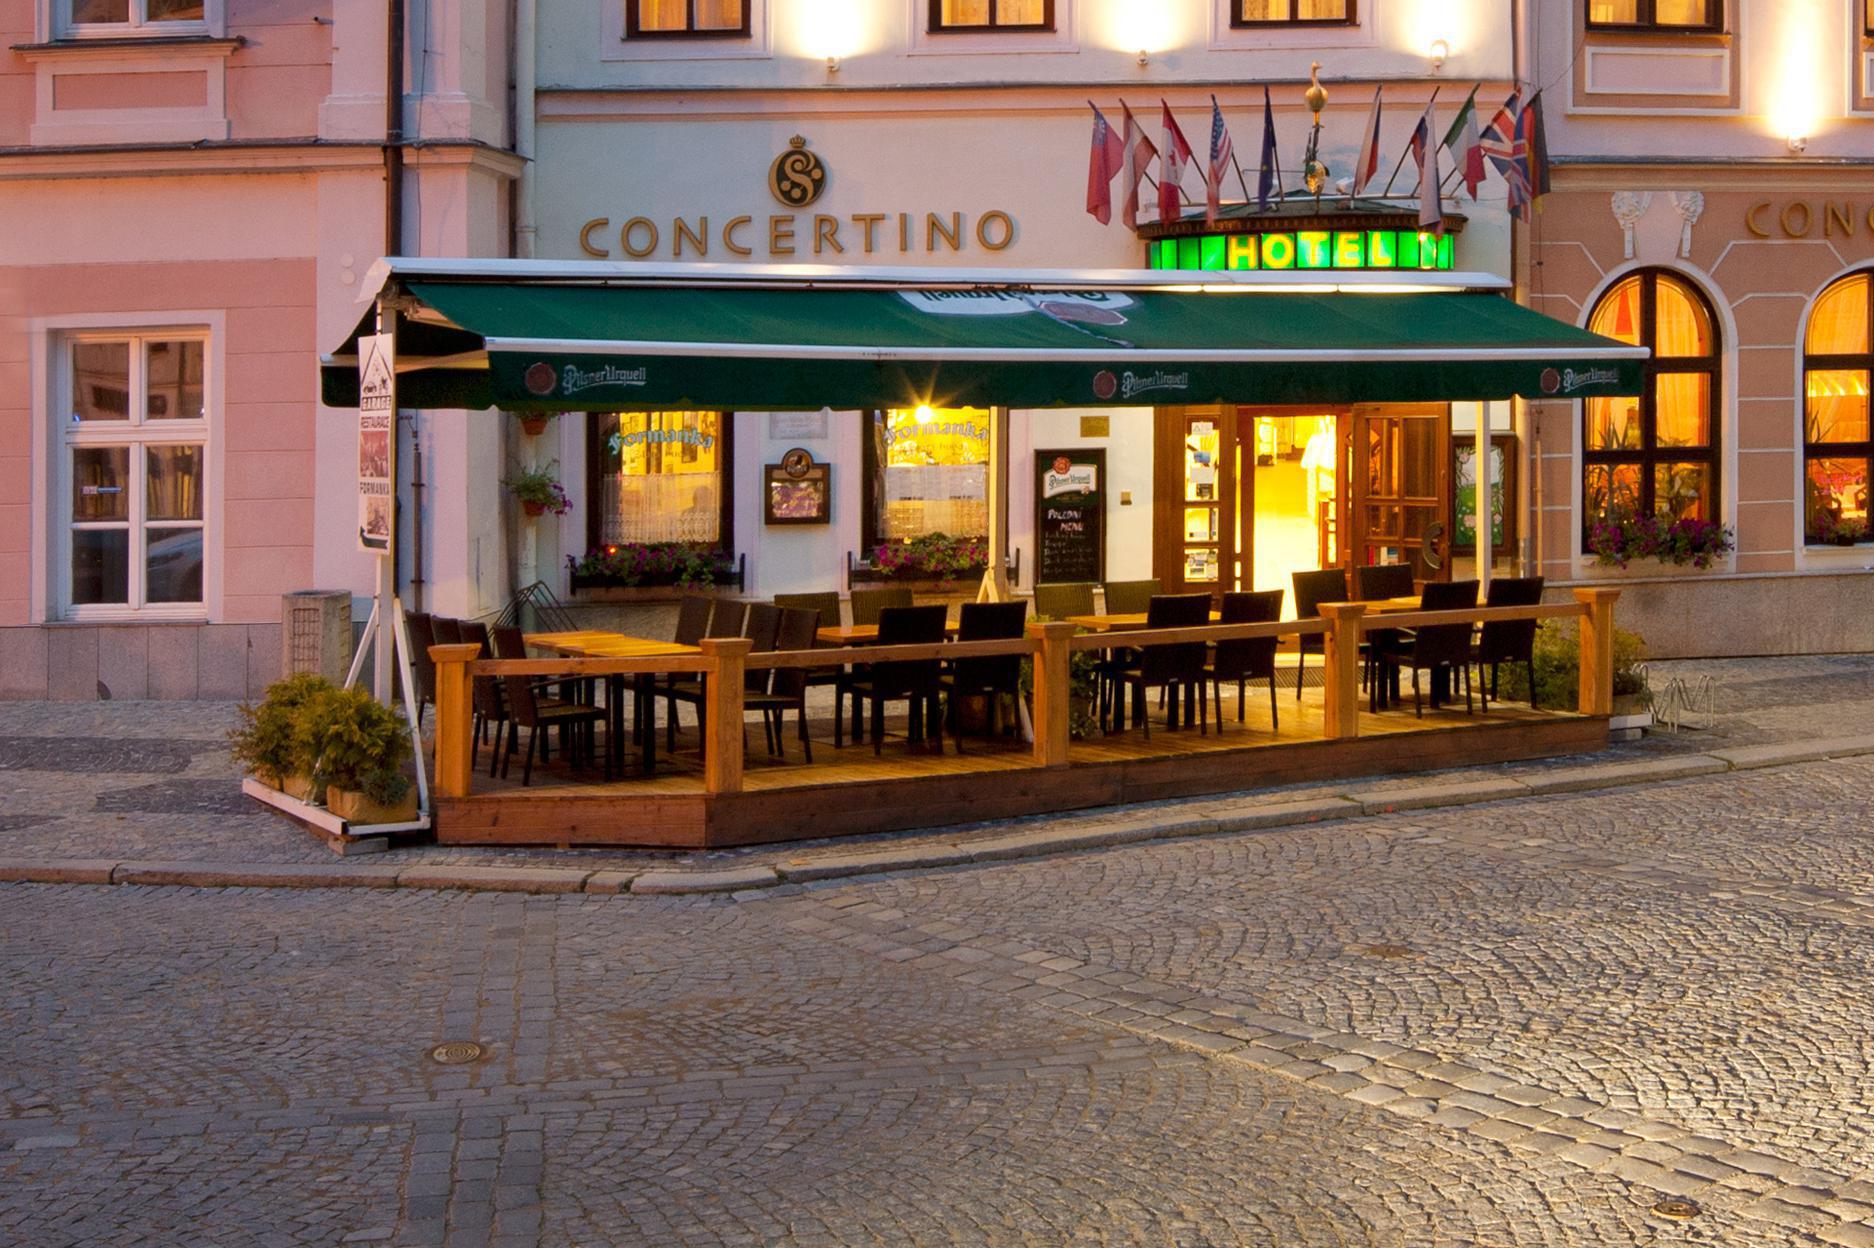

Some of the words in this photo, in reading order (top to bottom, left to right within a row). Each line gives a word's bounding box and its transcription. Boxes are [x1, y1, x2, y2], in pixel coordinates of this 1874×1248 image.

[580, 210, 1014, 257] CONCERTINO
[1228, 232, 1392, 268] HOTEL
[562, 364, 605, 395] Pilsner
[605, 364, 647, 386] Urquell
[1121, 371, 1158, 399] Pilsner
[1155, 370, 1189, 389] Urquell
